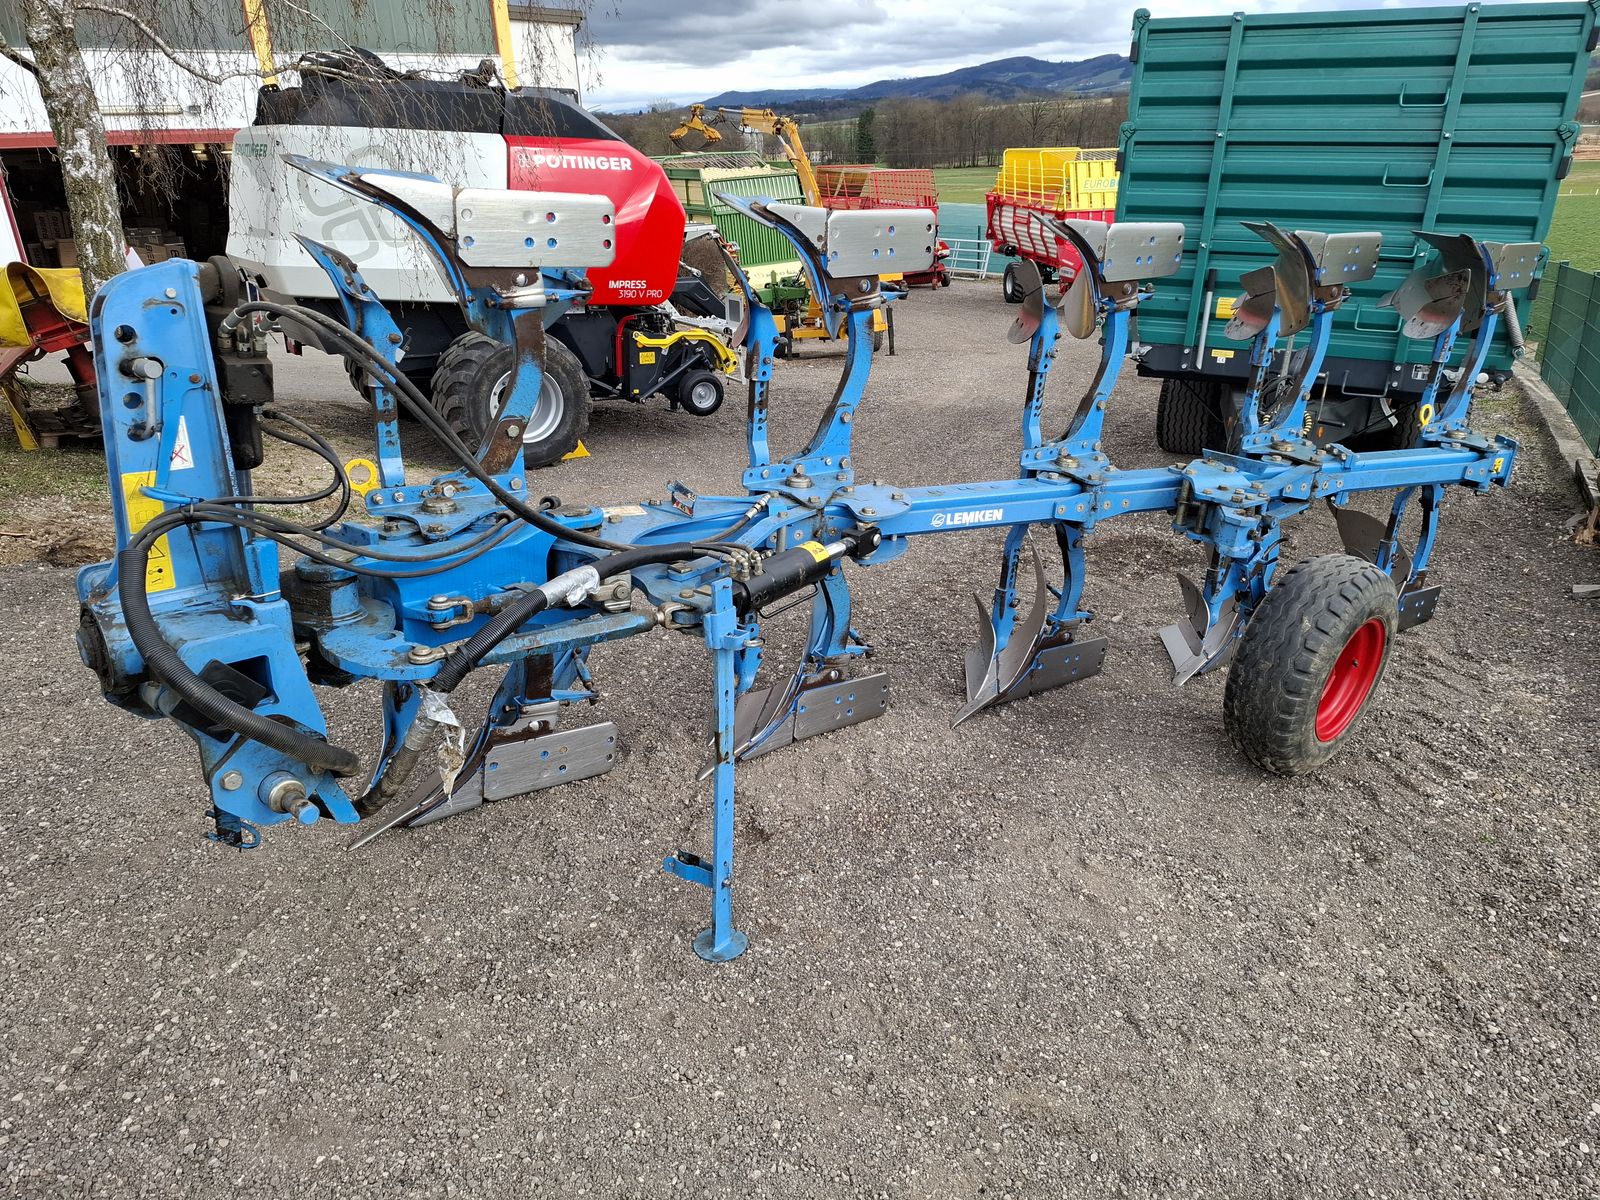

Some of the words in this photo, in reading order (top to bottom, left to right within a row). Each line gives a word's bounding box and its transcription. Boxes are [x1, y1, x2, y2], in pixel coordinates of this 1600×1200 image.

[608, 280, 647, 289] IMPRESS
[618, 289, 637, 299] 3190
[638, 289, 646, 299] V
[646, 289, 663, 298] PRO
[946, 508, 1004, 526] LEMKEN
